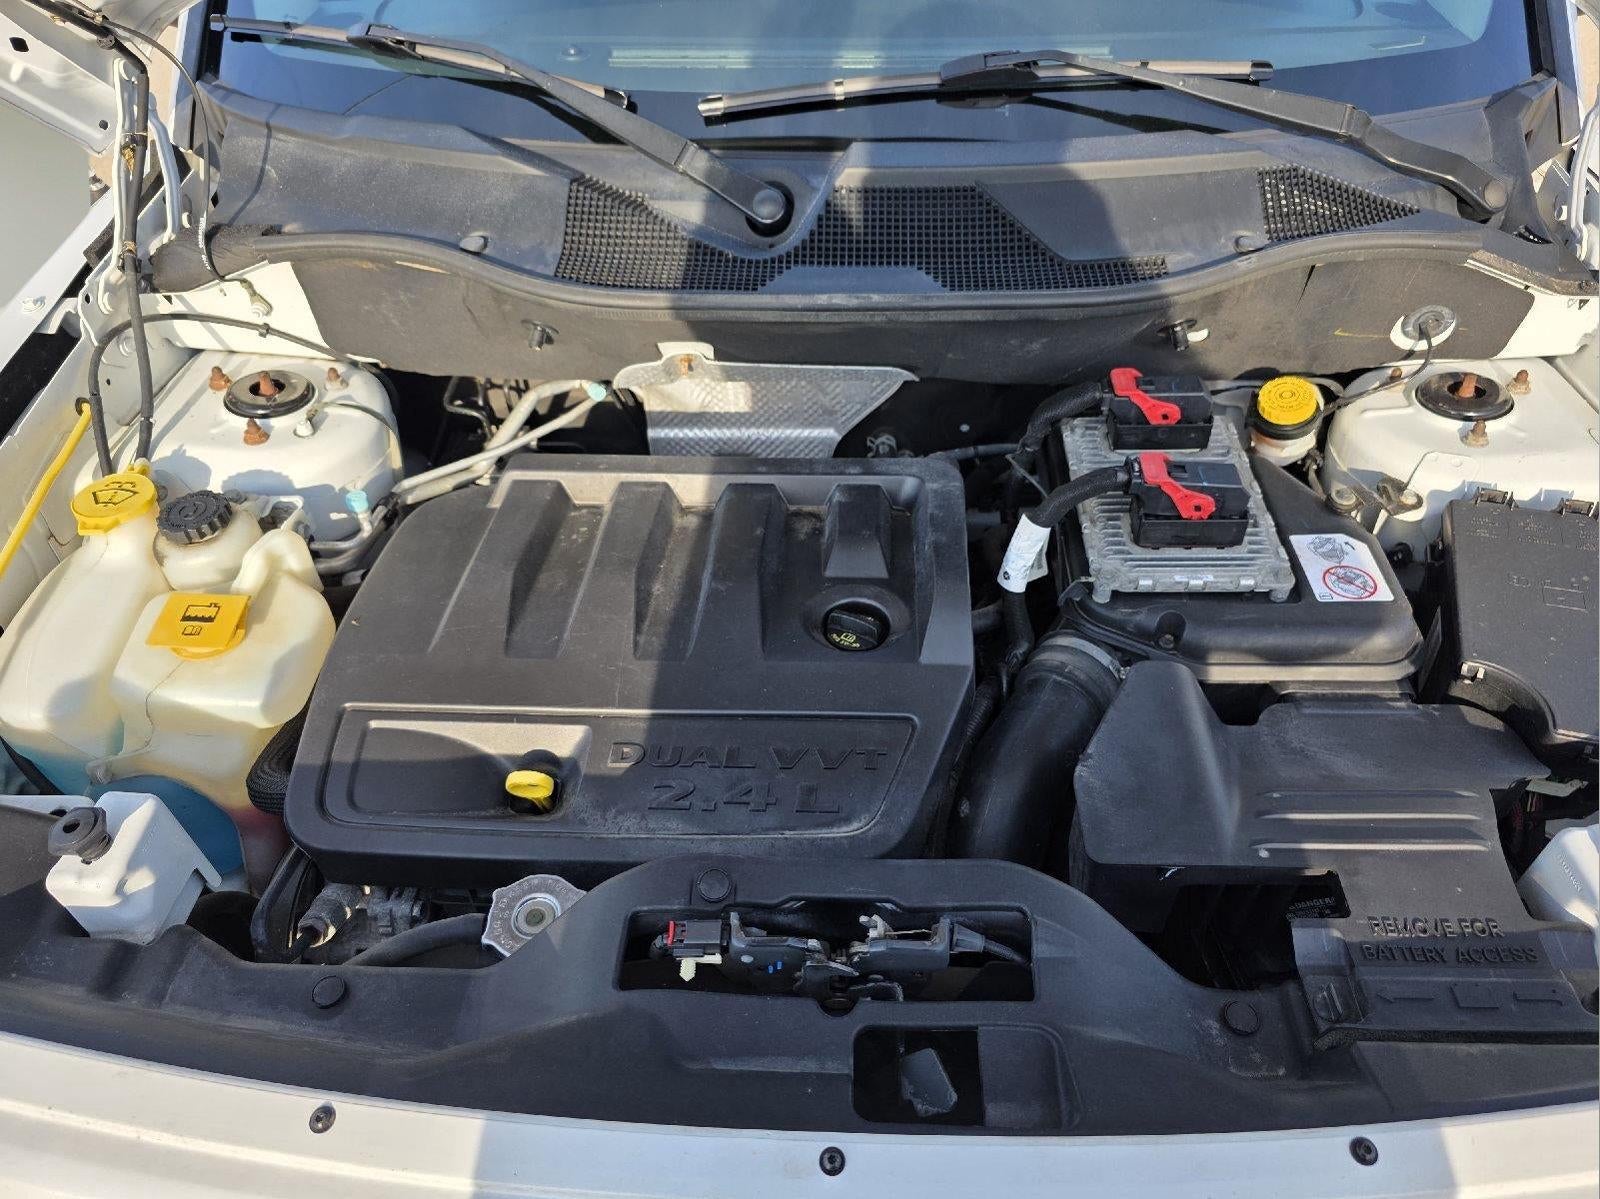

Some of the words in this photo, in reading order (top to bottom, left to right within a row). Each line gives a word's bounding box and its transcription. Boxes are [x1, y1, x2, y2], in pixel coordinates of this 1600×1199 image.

[607, 742, 756, 769] DUAL
[769, 745, 887, 770] VVT
[648, 778, 778, 812] 2.4
[795, 783, 841, 813] L
[1367, 916, 1460, 937] REMOVE
[1461, 917, 1505, 938] FOR
[1360, 944, 1447, 963] BATTERY
[1456, 947, 1540, 963] ACCESS
